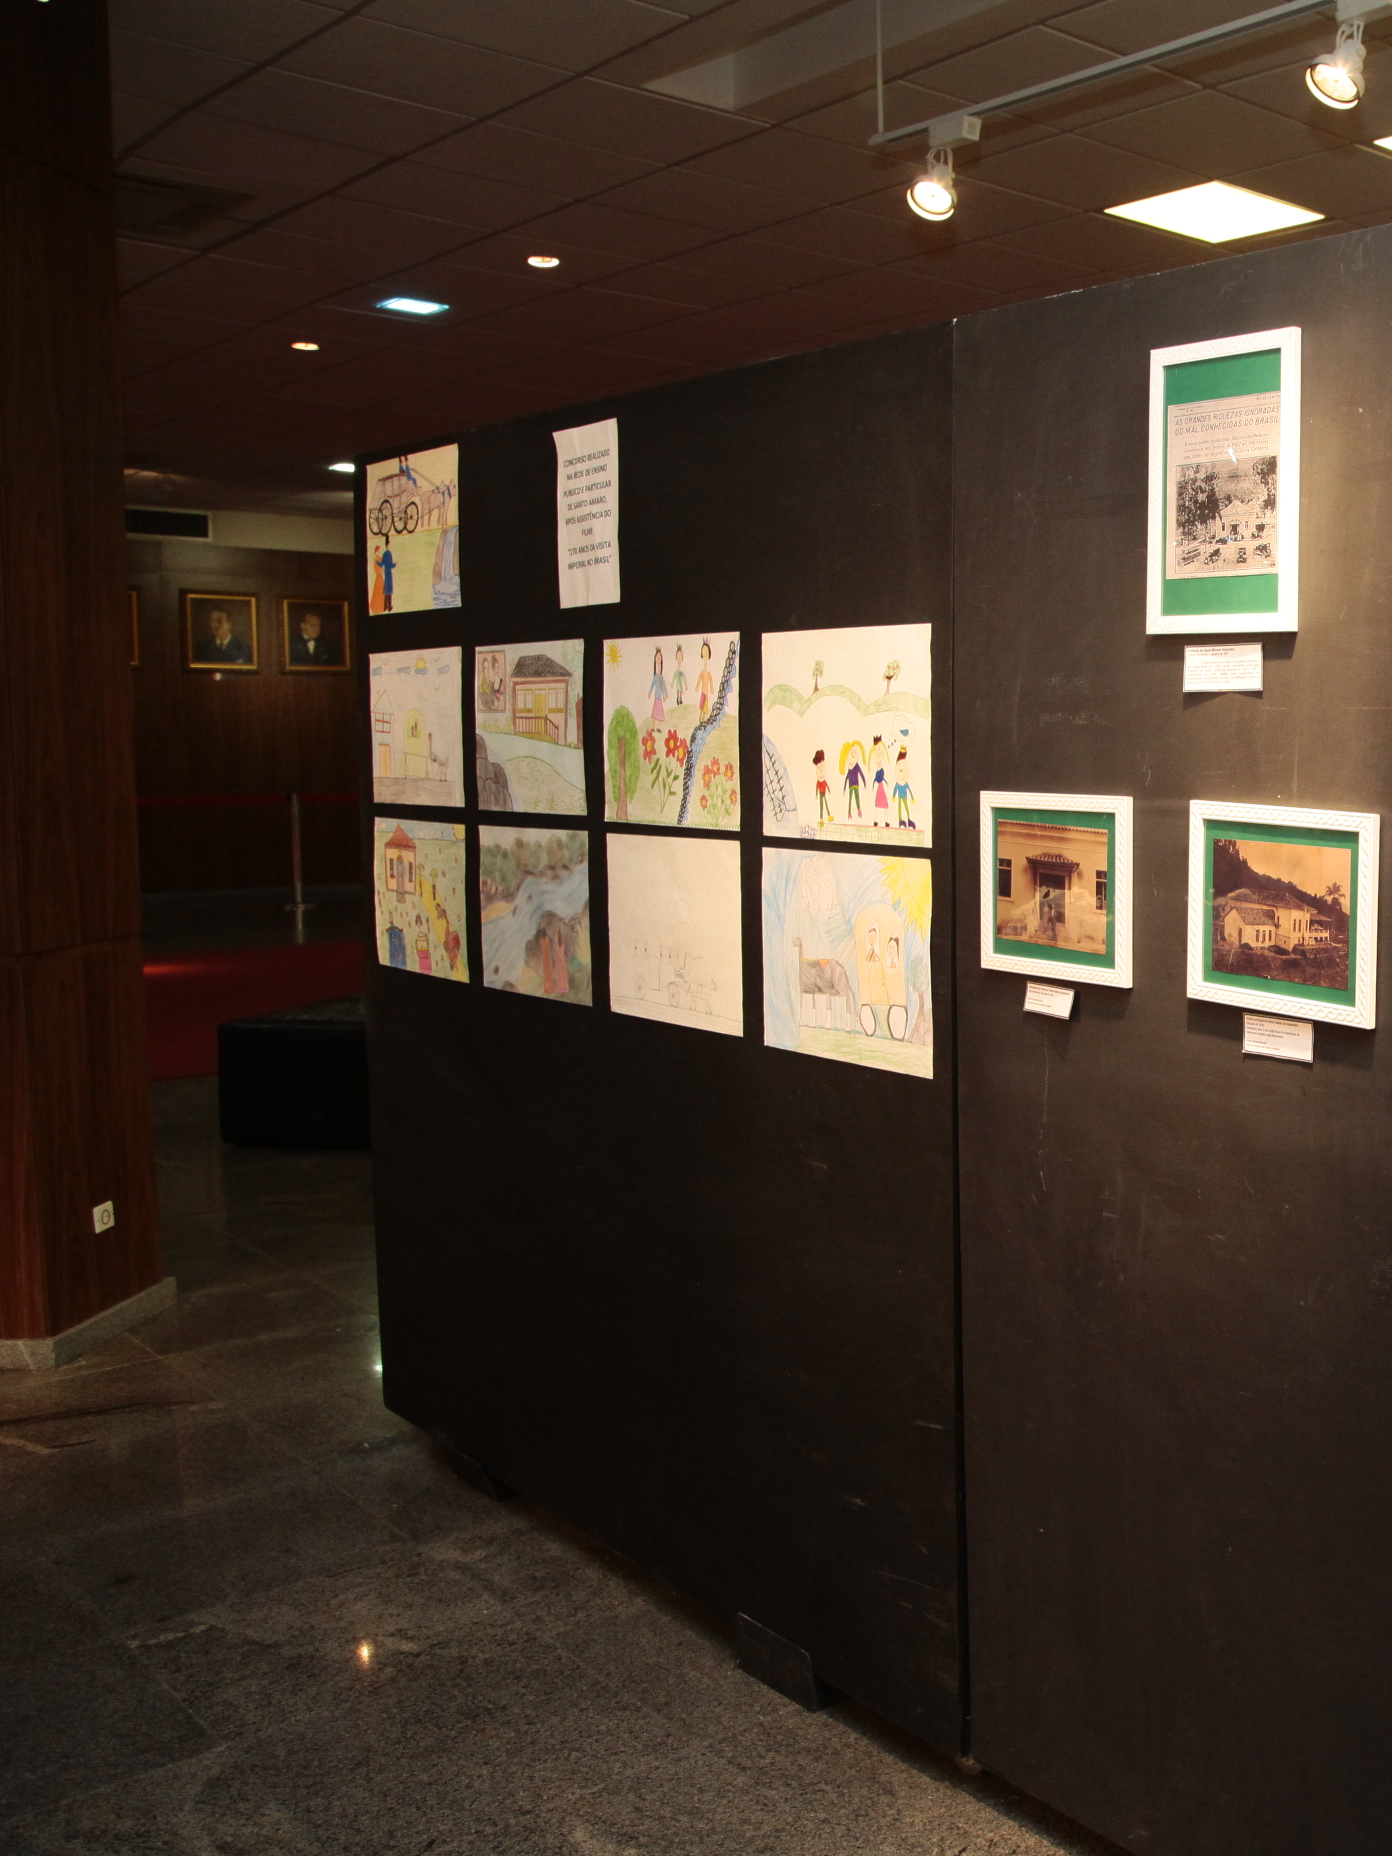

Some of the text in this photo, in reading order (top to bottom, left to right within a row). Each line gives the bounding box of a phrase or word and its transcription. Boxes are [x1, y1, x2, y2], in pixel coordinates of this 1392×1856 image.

[564, 449, 610, 468] CONCURSO REALIZADO
[574, 470, 584, 479] REDE
[591, 464, 607, 475] ENSINO
[585, 480, 612, 492] PARTICULAR
[574, 500, 588, 509] SANTO
[577, 511, 603, 523] ASSISTÊNCIA
[582, 527, 593, 536] FILME
[579, 545, 589, 553] ANOS
[596, 541, 611, 550] VISITA
